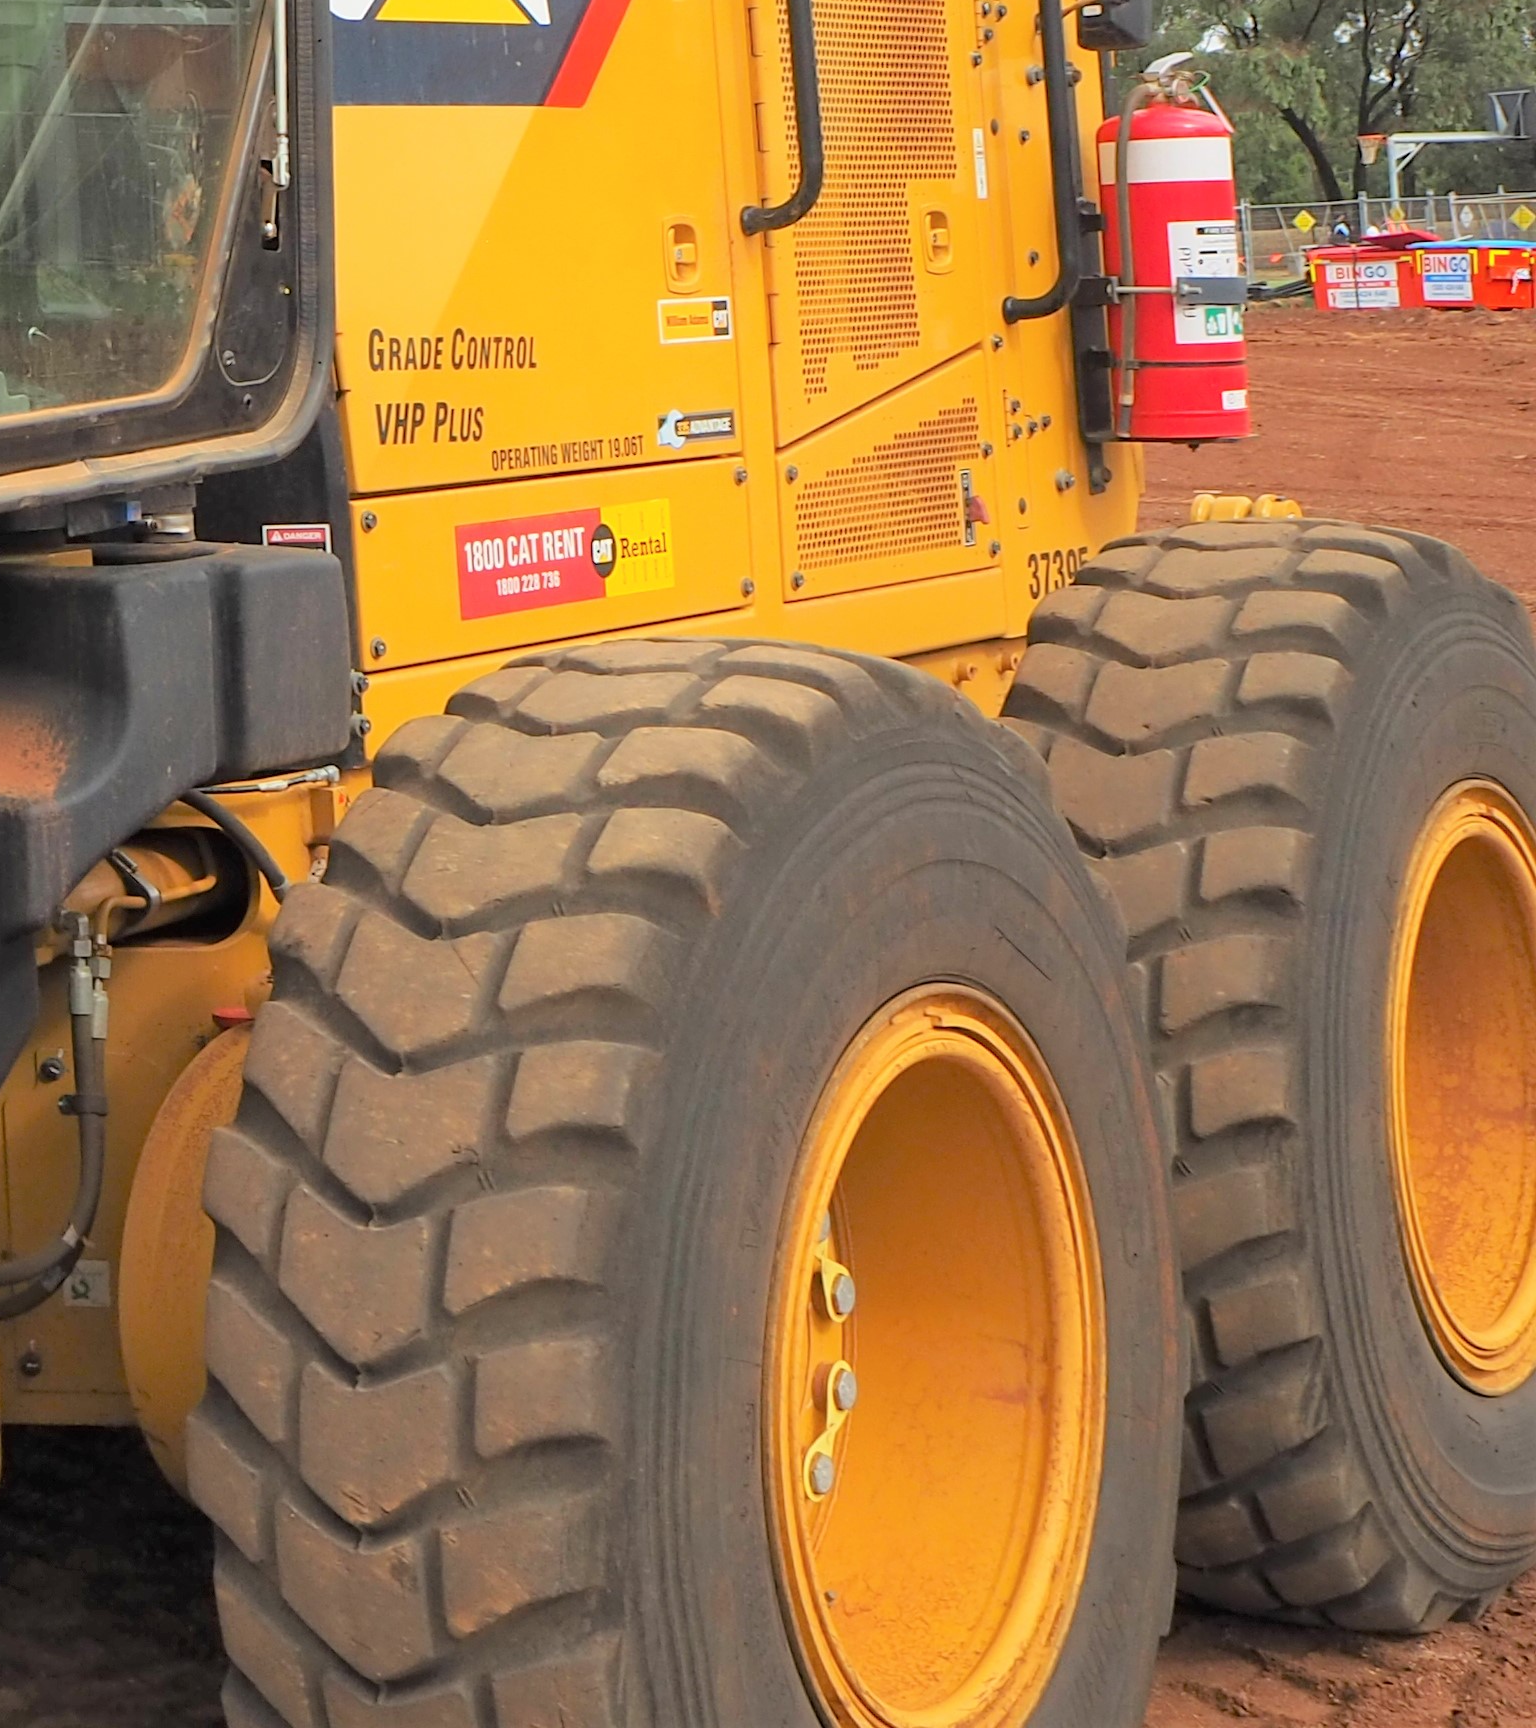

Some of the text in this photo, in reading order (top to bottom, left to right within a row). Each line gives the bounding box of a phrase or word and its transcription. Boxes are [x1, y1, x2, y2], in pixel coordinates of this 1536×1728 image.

[1336, 265, 1388, 280] BINGO
[1424, 257, 1469, 273] BINGO
[368, 328, 537, 371] GRADE CONTROL
[375, 402, 484, 445] VHP PLUS
[491, 435, 644, 471] OPERATING WEIGHT 19.06T
[283, 532, 322, 540] DANGER
[620, 532, 668, 559] Rental
[464, 527, 585, 573] 1800 CAT RENT
[592, 538, 614, 565] CAT
[496, 571, 560, 596] 1800 228 736
